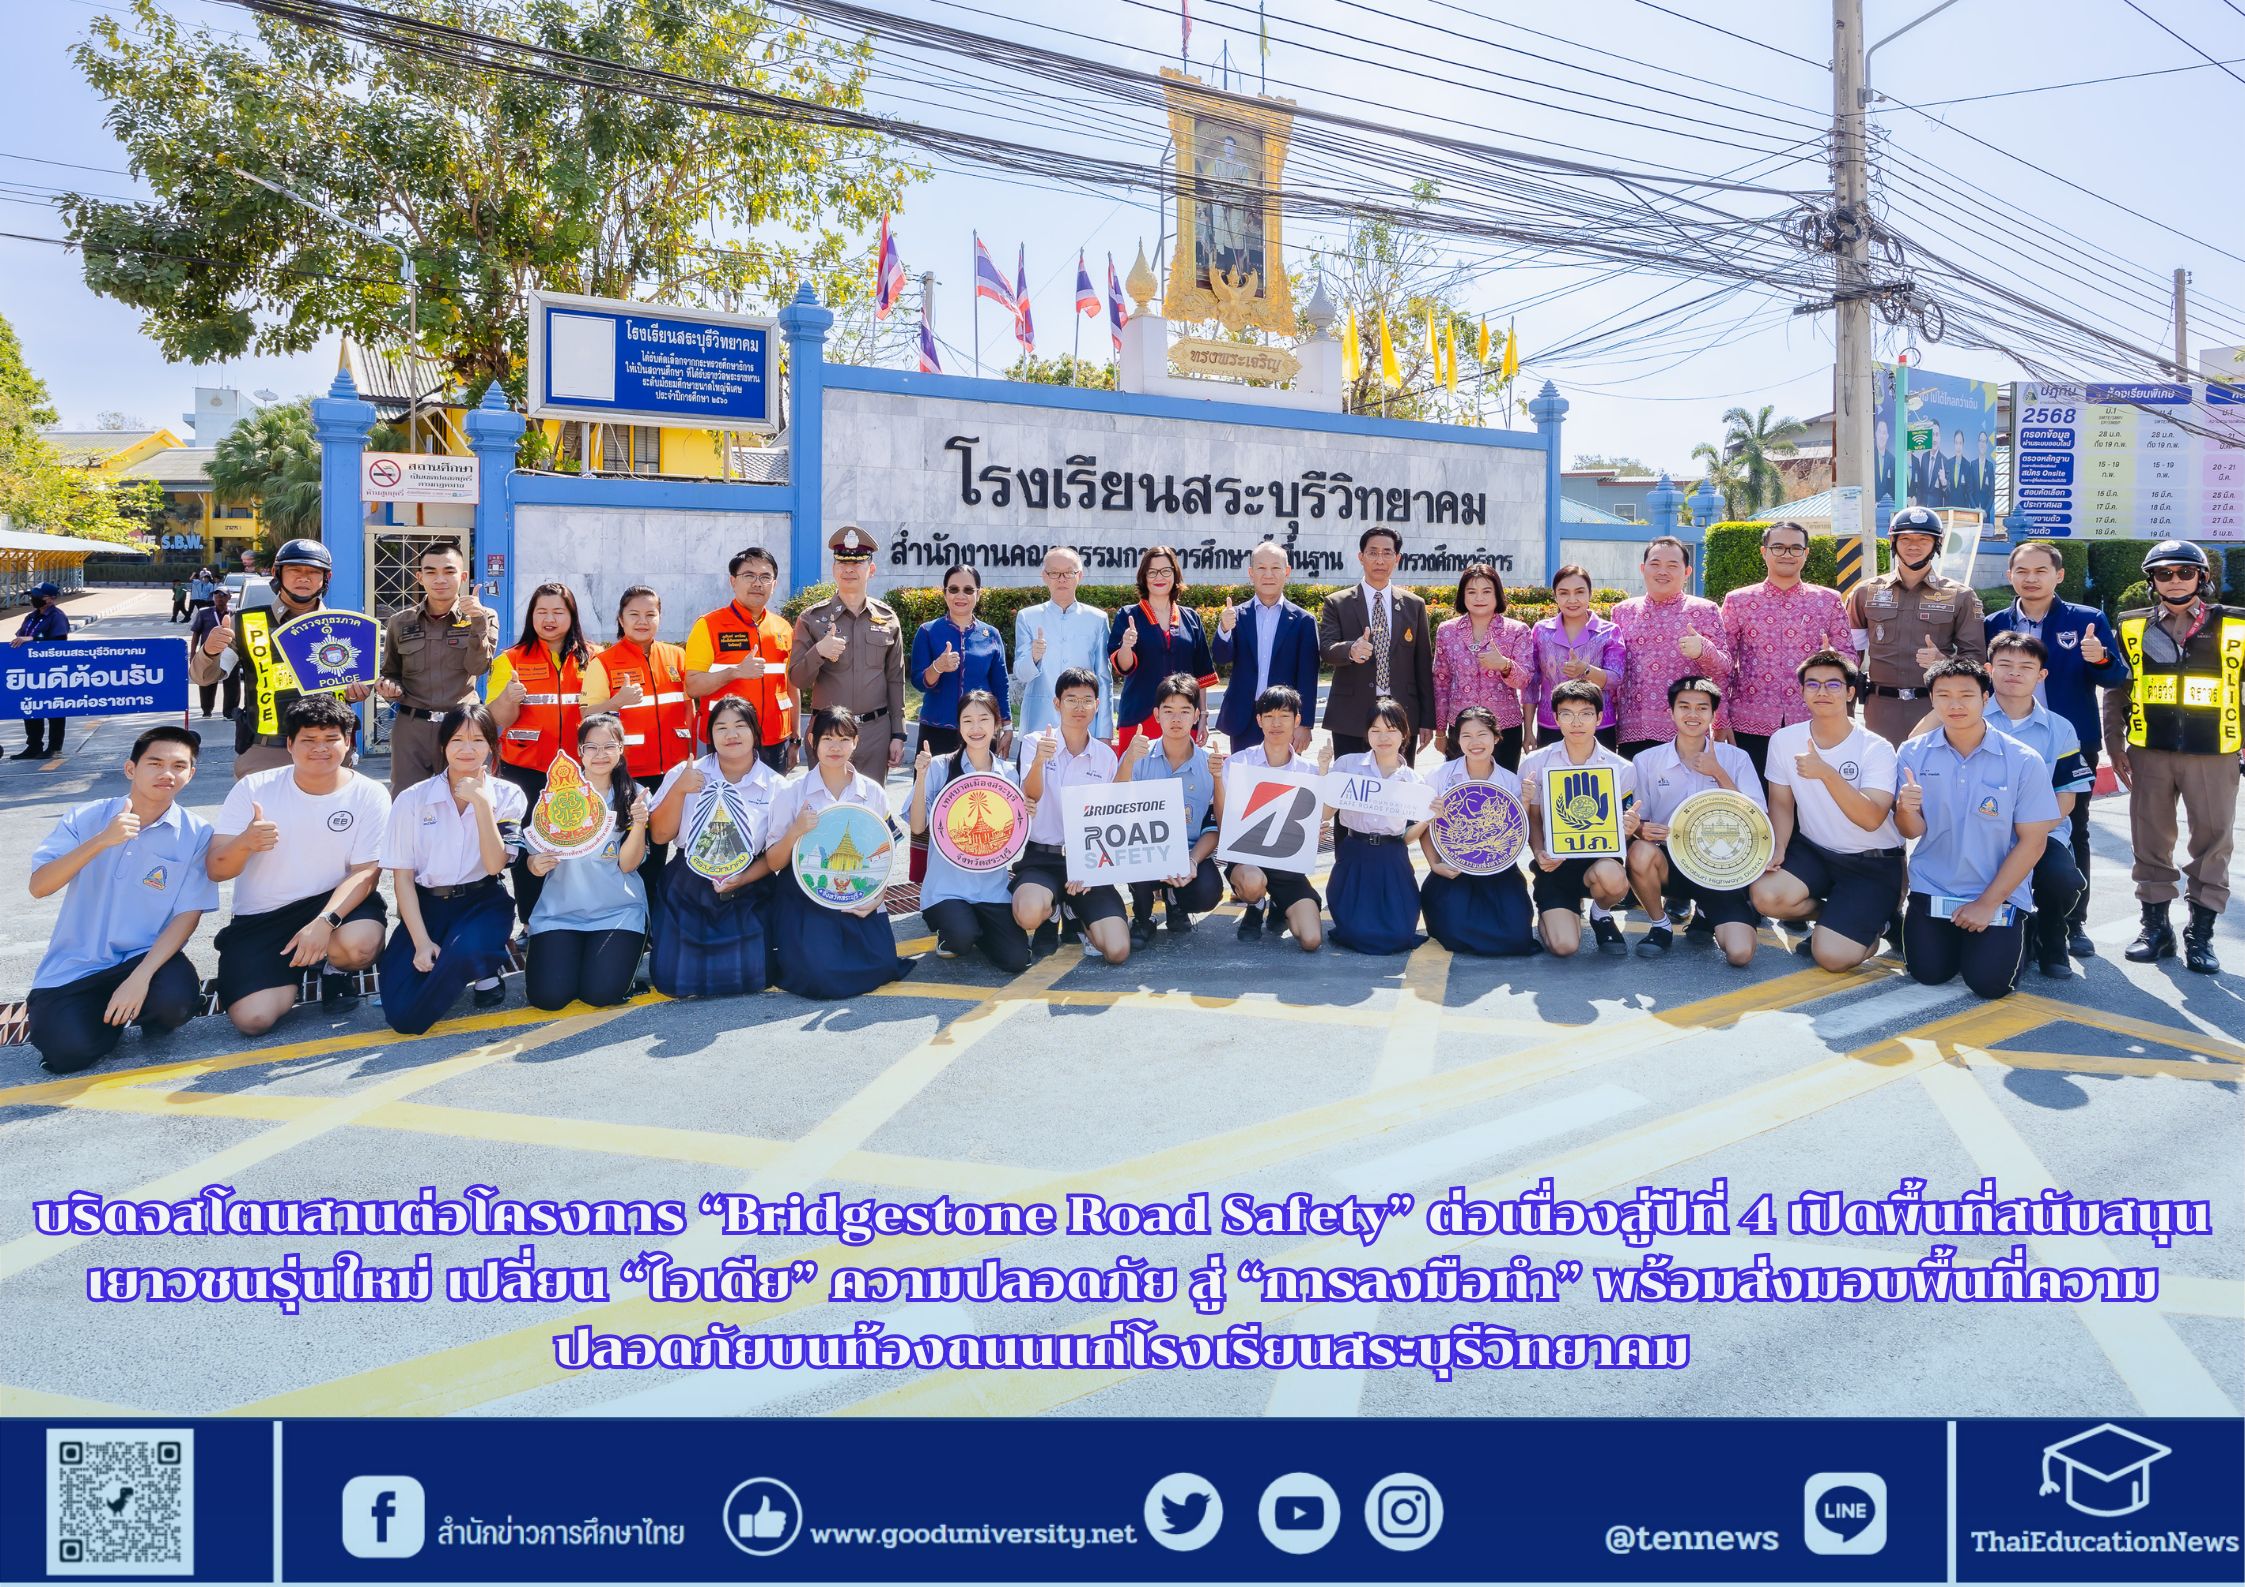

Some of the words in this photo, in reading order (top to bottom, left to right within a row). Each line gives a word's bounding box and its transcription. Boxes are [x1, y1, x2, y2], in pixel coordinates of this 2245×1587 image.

[626, 320, 759, 353] โรงเรียนสระบุรีวิทยาคม
[1190, 350, 1281, 373] ทรงพระเจริญ
[2022, 408, 2076, 423] 2568
[2023, 429, 2071, 441] กรอกข้อมูล
[408, 462, 473, 473] สถานศึกษา
[945, 435, 1486, 533] โรงเรียนสระบุรีวิทยาคม
[162, 534, 204, 549] S.B.W.
[290, 616, 362, 636] ตำรวจภูธรภาค
[28, 646, 146, 660] โรงเรียนสระบุรีวิทยาคม
[5, 664, 164, 691] ยินดีต้อนรับ
[250, 630, 273, 722] POLICE
[319, 673, 361, 688] POLICE
[2225, 640, 2241, 739] POLICE
[20, 694, 154, 716] ผู้มาติดต่อราชการ
[942, 777, 1019, 809] เทศบาลเมืองสระบุรี
[1340, 777, 1382, 802] AIP
[1083, 799, 1166, 818] BRIDGESTONE
[1084, 820, 1170, 852] ROAD
[1565, 834, 1613, 851] ปภ.
[1085, 844, 1171, 870] SAFETY
[1680, 858, 1707, 881] Saraburi
[1708, 875, 1744, 886] Highways
[1743, 857, 1764, 878] District
